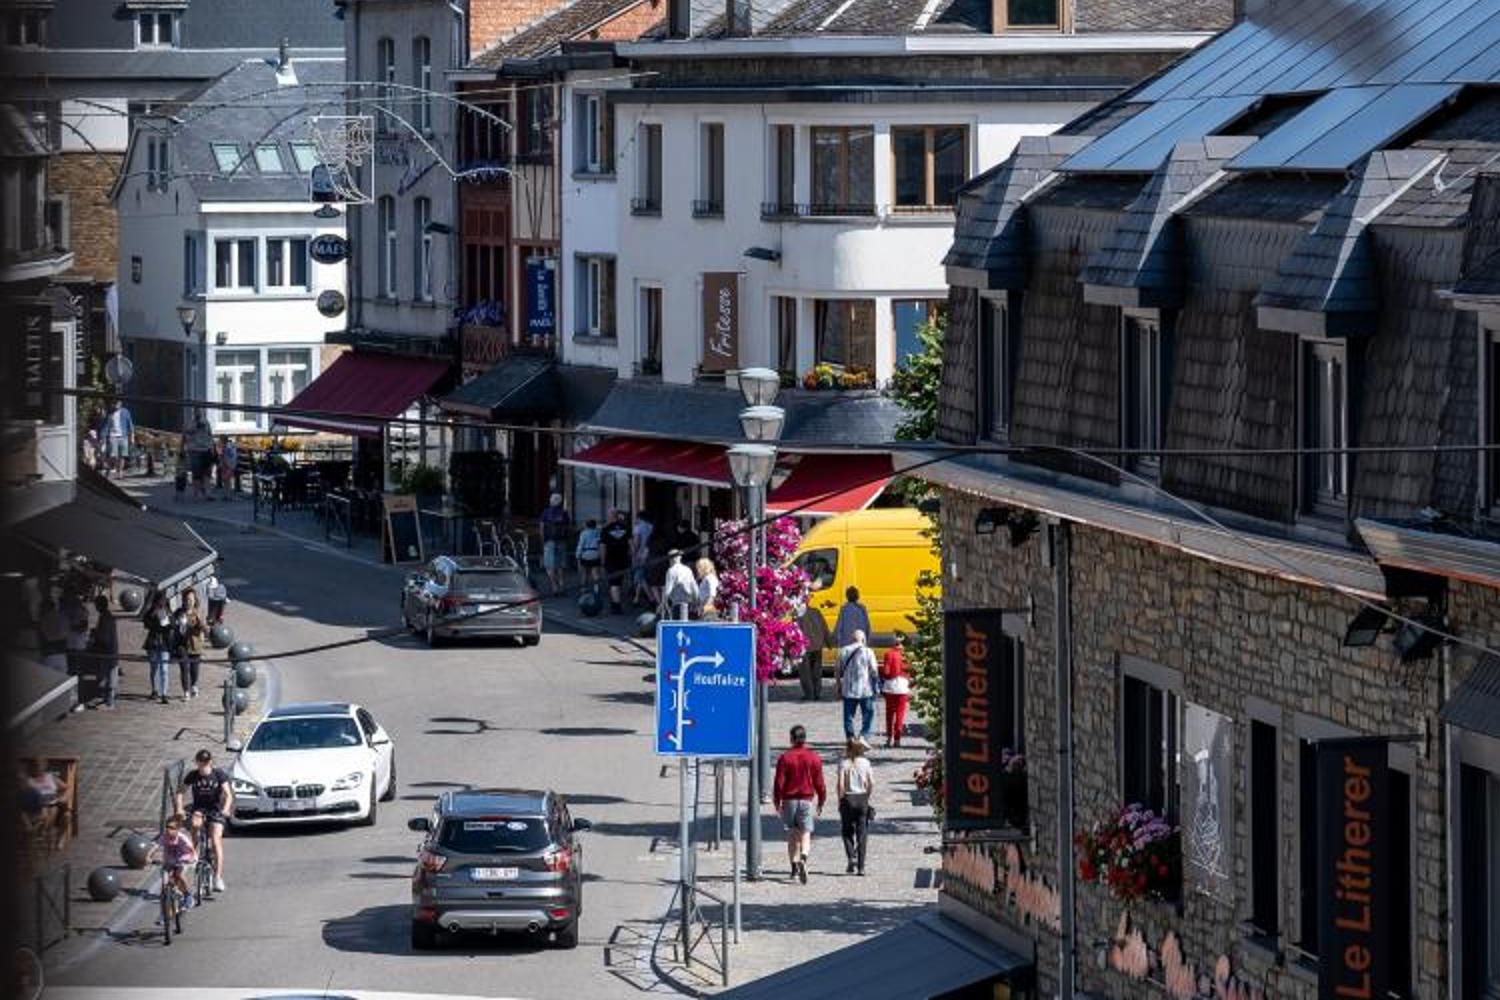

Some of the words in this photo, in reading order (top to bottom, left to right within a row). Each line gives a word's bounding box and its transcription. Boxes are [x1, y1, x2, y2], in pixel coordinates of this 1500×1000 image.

[960, 624, 989, 764] Litherer
[961, 772, 989, 817] Le
[1336, 755, 1373, 932] Litherer
[1336, 949, 1372, 999] Le
